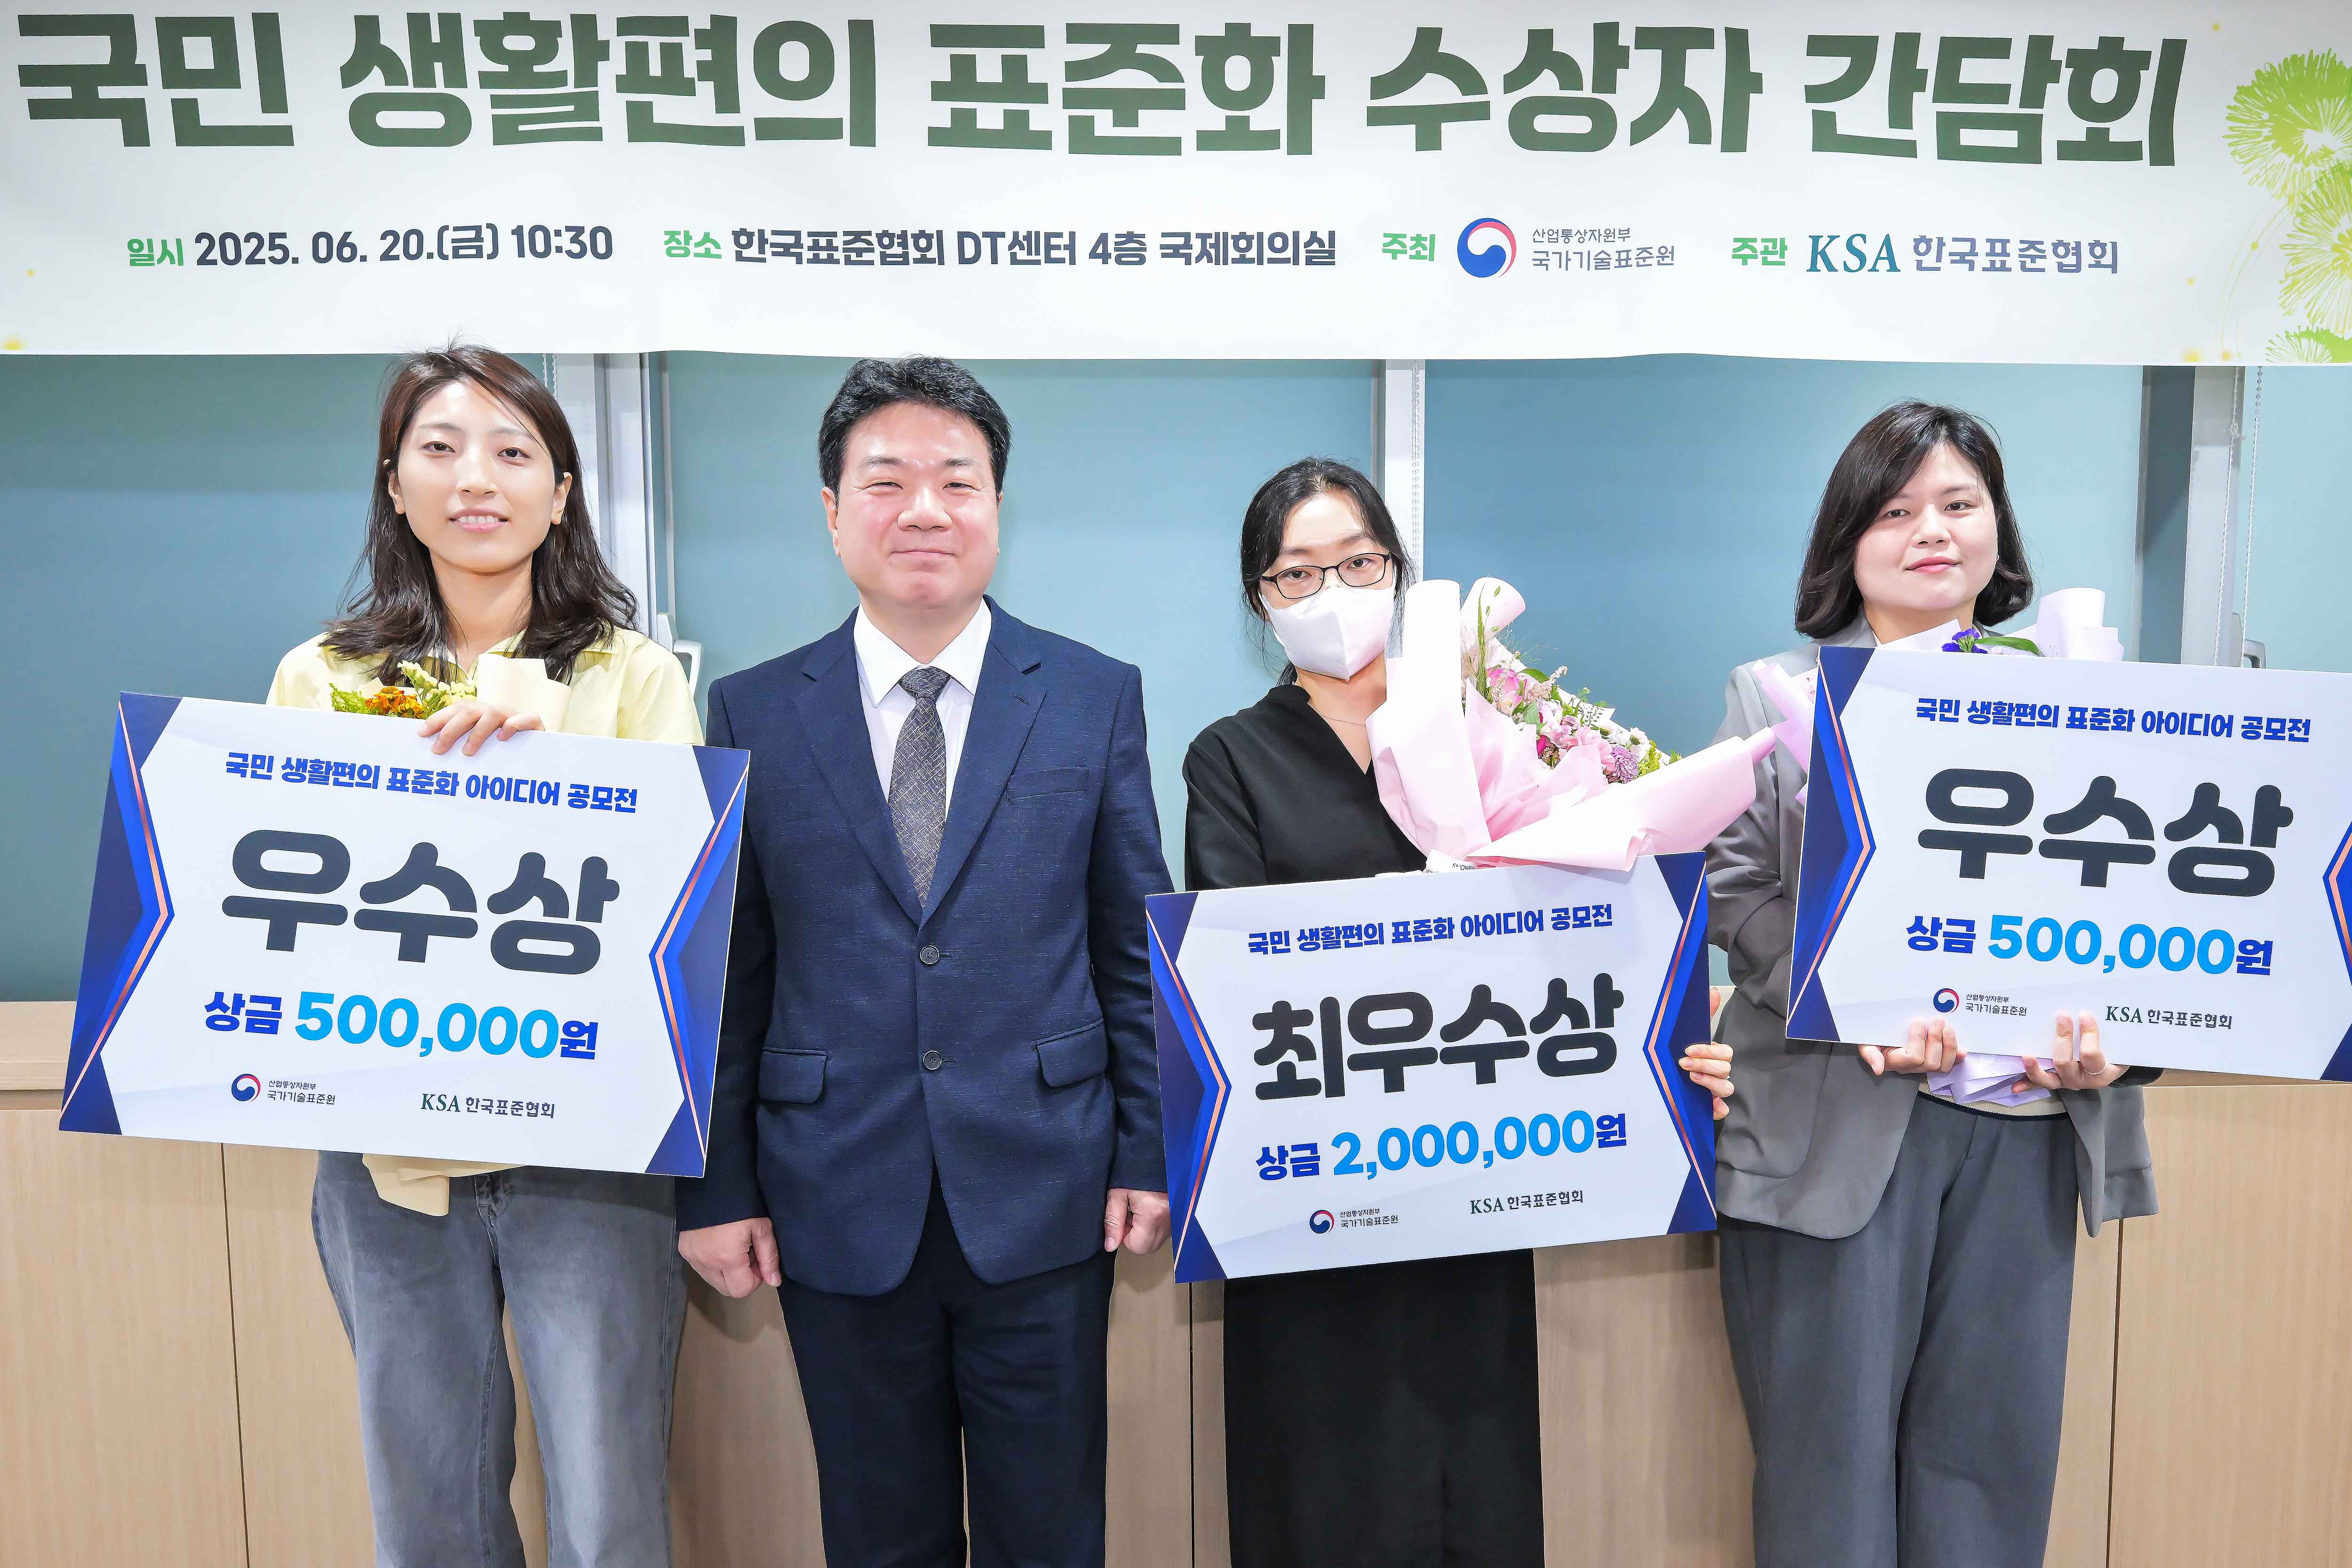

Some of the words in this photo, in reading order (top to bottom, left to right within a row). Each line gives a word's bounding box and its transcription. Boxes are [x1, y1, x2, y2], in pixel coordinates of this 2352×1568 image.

[18, 12, 294, 147] 국민
[340, 12, 876, 147] 생활편의
[928, 23, 1325, 156] 표준화
[1367, 22, 1763, 152] 수상자
[1804, 32, 2187, 166] 간담회
[127, 238, 183, 266] 일시
[195, 232, 299, 265] 2025.
[312, 231, 367, 263] 06.
[511, 225, 612, 259] 10:30
[664, 230, 722, 259] 장소
[732, 228, 945, 265] 한국표준협회
[957, 231, 1076, 265] DT센터
[1089, 231, 1146, 265] 4층
[1160, 230, 1335, 265] 국제회의실
[1382, 233, 1435, 261] 주최
[1533, 228, 1630, 244] 산업통상자원부
[1732, 238, 1788, 266] 주관
[1532, 246, 1675, 271] 국가기술표준원
[1806, 234, 1900, 272] KSA
[1914, 236, 2117, 273] 한국표준협회
[1916, 698, 1960, 722] 국민
[1967, 701, 2059, 728] 생활편의
[2066, 706, 2135, 732] 표준화
[2142, 711, 2233, 737] 아이디어
[2241, 716, 2311, 742] 공모전
[226, 752, 274, 780] 국민
[281, 757, 380, 789] 생활편의
[387, 768, 459, 796] 표준화
[466, 775, 560, 806] 아이디어
[568, 784, 637, 813] 공모전
[1918, 768, 2293, 897] 우수상
[222, 830, 620, 974] 우수상
[1248, 930, 1291, 955] 국민
[1296, 923, 1384, 951] 생활편의
[1392, 917, 1454, 943] 표준화
[1461, 910, 1543, 937] 아이디어
[1551, 904, 1612, 930] 공모전
[1907, 916, 1976, 953] 상금
[205, 992, 282, 1035] 상금
[1965, 1002, 2027, 1016] 국가기술표준원
[1966, 994, 2009, 1004] 산업통상자원부
[2106, 1006, 2143, 1023] KSA
[2148, 1009, 2232, 1029] 한국표준협회
[1253, 973, 1624, 1100] 최우수상
[267, 1090, 335, 1105] 국가기술표준원
[269, 1080, 316, 1090] 산업통상자원부
[421, 1093, 461, 1112] KSA
[466, 1097, 555, 1118] 한국표준협회
[1256, 1143, 1320, 1180] 상금
[1340, 1208, 1381, 1218] 산업통상자원부
[1470, 1197, 1504, 1214] KSA
[1507, 1190, 1583, 1210] 한국표준협회
[1340, 1213, 1398, 1228] 국가기술표준원
